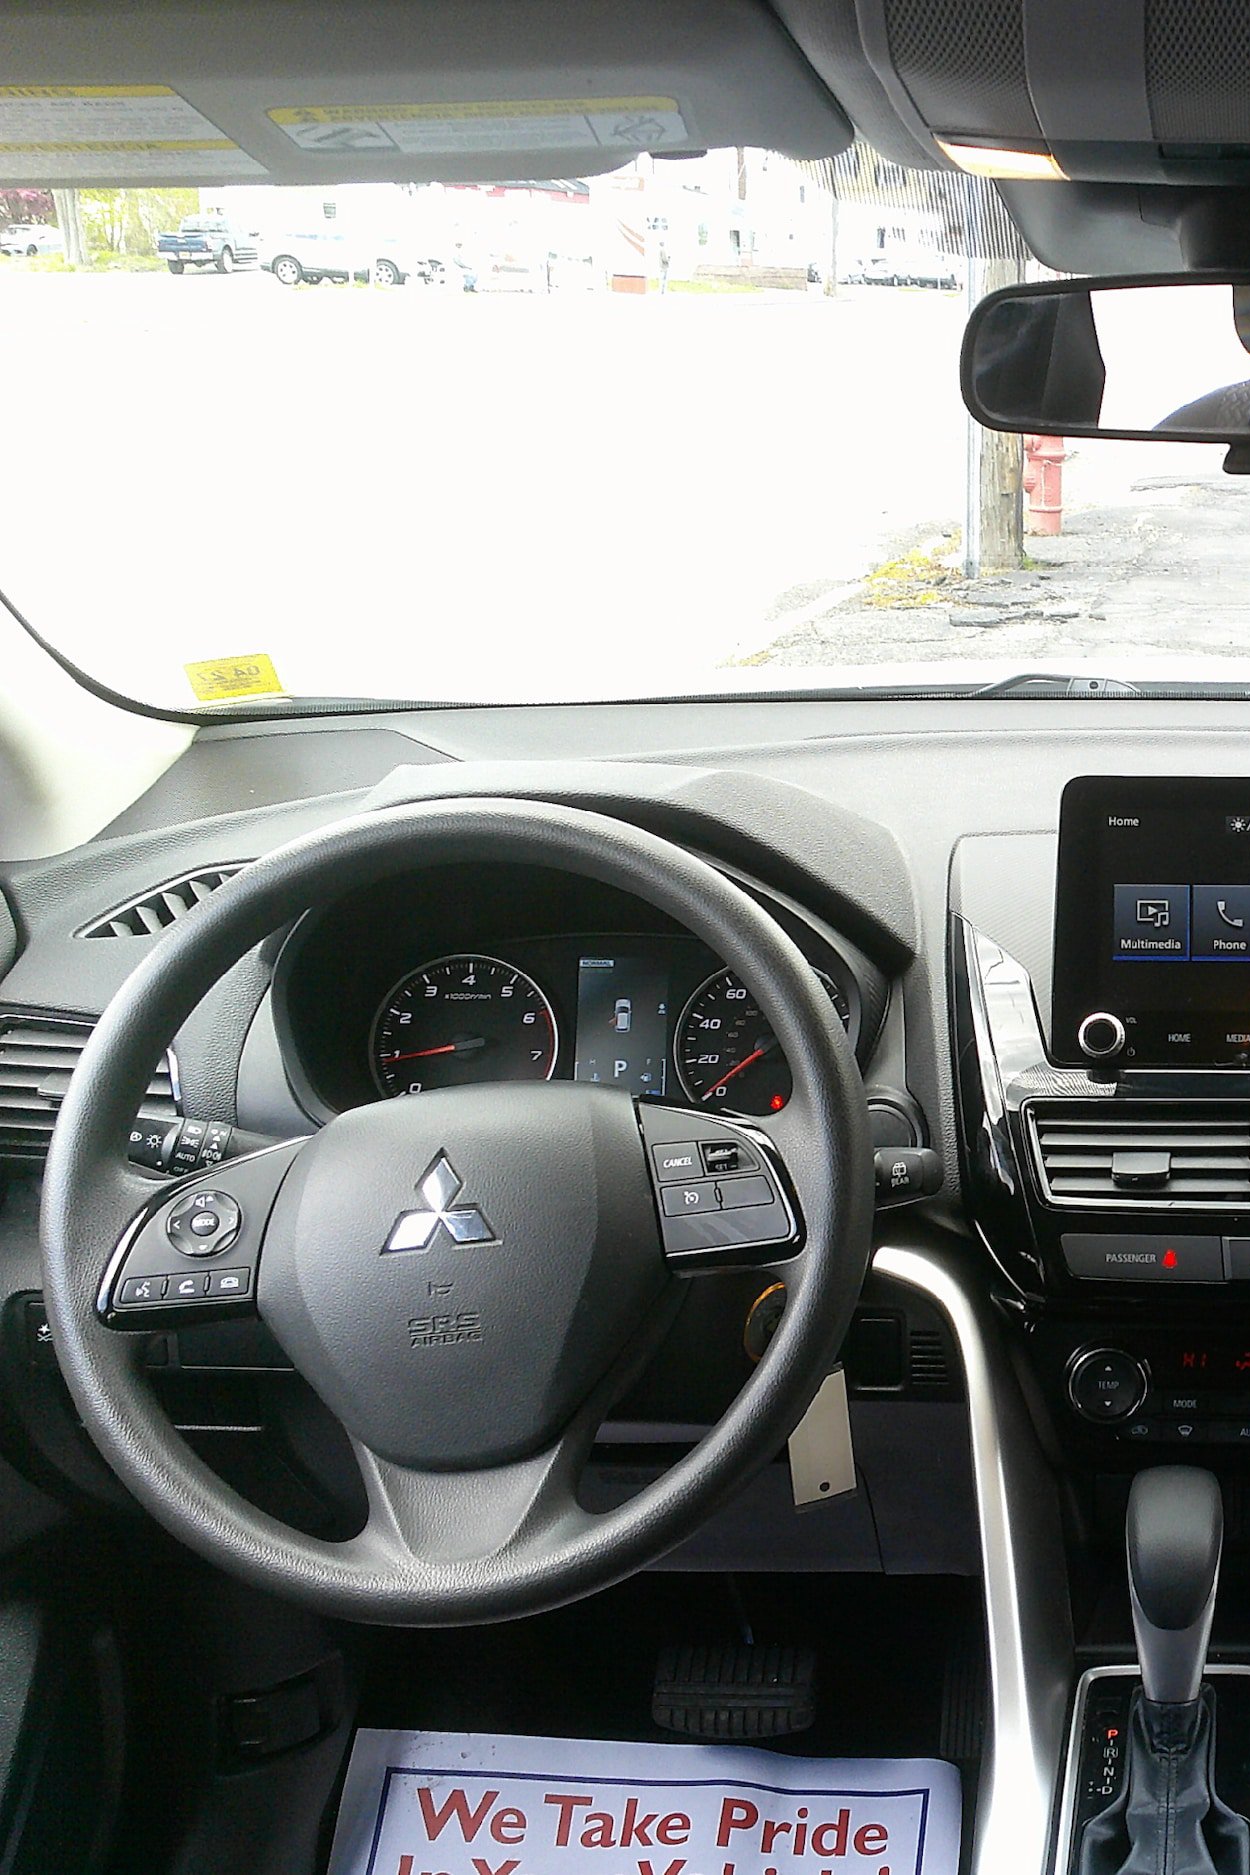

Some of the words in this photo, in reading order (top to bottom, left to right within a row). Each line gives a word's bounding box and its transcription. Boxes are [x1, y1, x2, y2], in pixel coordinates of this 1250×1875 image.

[1108, 815, 1139, 827] Home
[1120, 938, 1182, 951] Multimedia
[1212, 938, 1247, 951] Phone
[462, 974, 476, 985] 4
[424, 986, 438, 997] 3
[500, 986, 514, 998] 5
[725, 988, 747, 1000] 60
[399, 1012, 412, 1024] 2
[522, 1012, 536, 1024] 6
[699, 1018, 721, 1029] 40
[1168, 1034, 1191, 1043] HOME
[530, 1051, 542, 1061] 7
[697, 1054, 719, 1064] 20
[613, 1060, 628, 1078] P
[409, 1082, 422, 1094] 0
[715, 1086, 727, 1097] 0
[175, 1152, 196, 1163] AUTO
[663, 1156, 693, 1168] CANCEL
[1105, 1252, 1157, 1265] PASSENGER
[407, 1312, 481, 1333] SRS
[410, 1332, 483, 1348] AIRBAG
[1098, 1380, 1120, 1391] TEMP
[1173, 1399, 1197, 1409] MODE
[1107, 1729, 1118, 1740] P
[1103, 1766, 1115, 1777] N
[1101, 1785, 1113, 1795] D
[416, 1787, 528, 1846] We
[543, 1793, 692, 1849] Take
[715, 1796, 890, 1859] Pride
